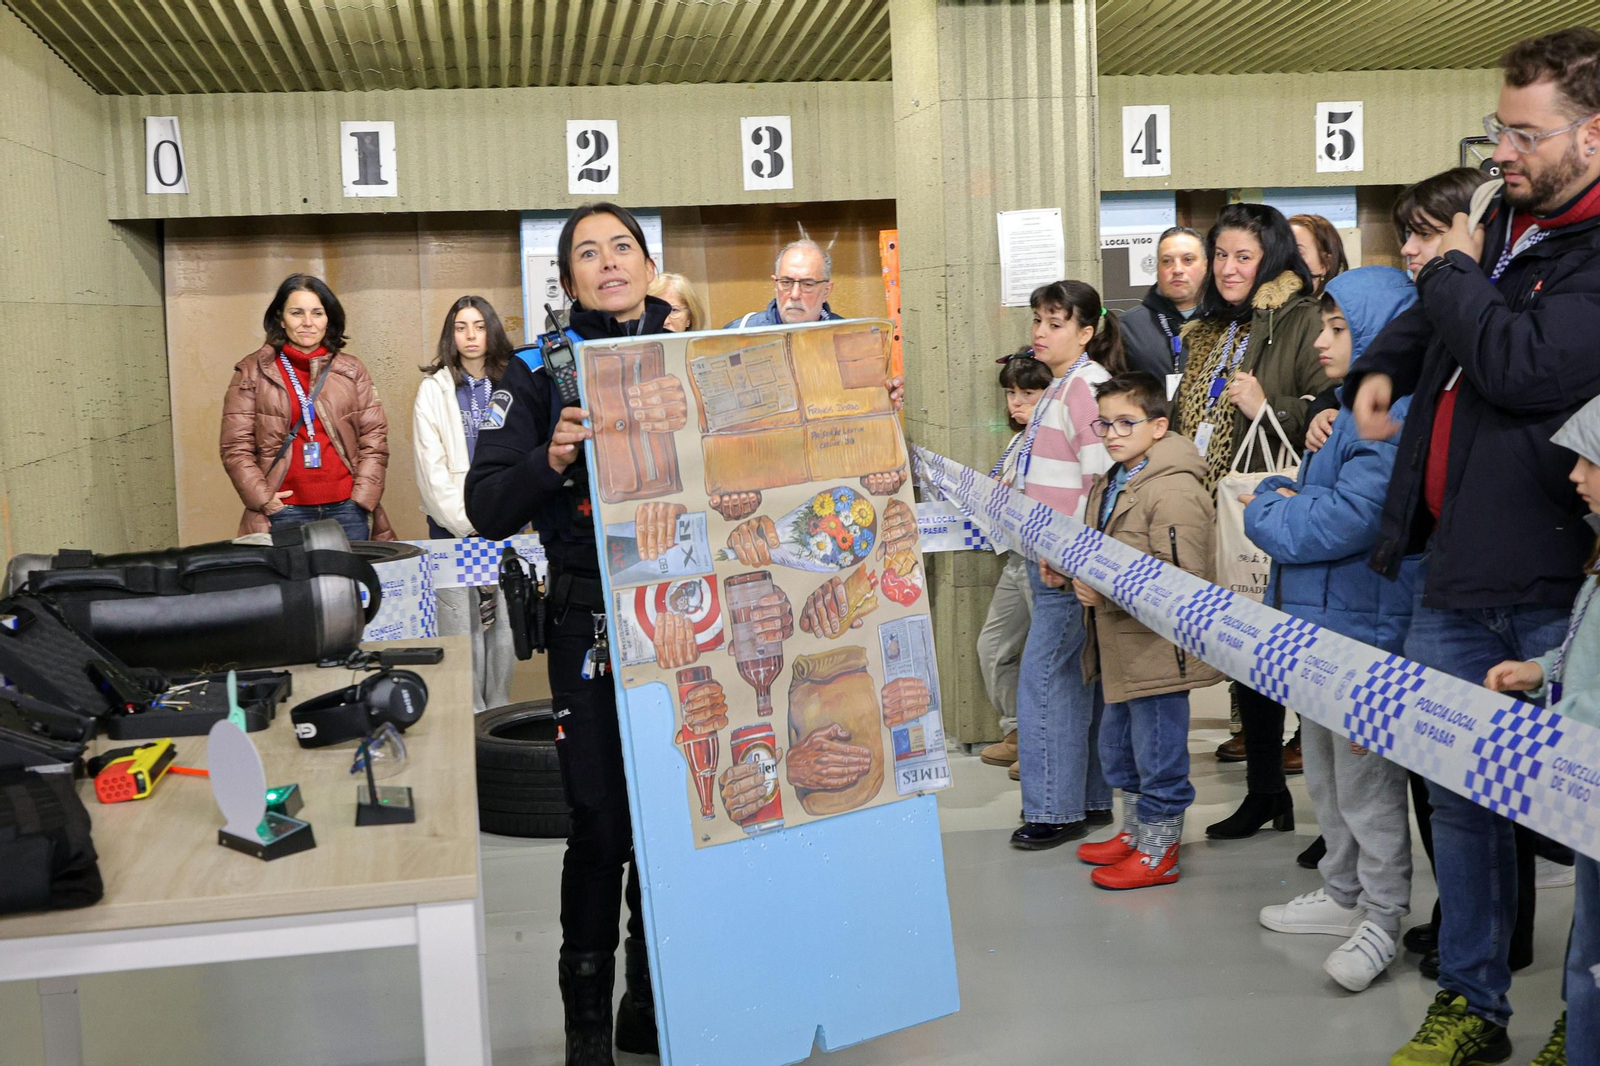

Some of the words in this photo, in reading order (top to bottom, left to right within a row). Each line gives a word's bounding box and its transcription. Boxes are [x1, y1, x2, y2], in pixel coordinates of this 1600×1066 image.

[1130, 113, 1162, 165] 4
[1324, 111, 1356, 161] 5
[153, 139, 183, 187] 0
[349, 131, 389, 186] 1
[576, 129, 611, 183] 2
[751, 125, 784, 179] 3
[1132, 237, 1153, 245] VIGO
[923, 527, 948, 535] PASAR
[610, 541, 626, 569] JVC
[370, 622, 404, 637] CONCELLO
[1220, 614, 1243, 632] POLICIA
[1240, 624, 1262, 638] LOCAL
[1217, 631, 1227, 642] NO
[1226, 634, 1244, 651] PASAR
[1300, 667, 1310, 680] DE
[1311, 670, 1327, 686] VIGO
[1304, 655, 1339, 675] CONCELLO
[1414, 697, 1450, 719] POLICIA
[1447, 710, 1477, 731] LOCAL
[1414, 720, 1428, 735] NO
[1427, 725, 1456, 748] PASAR
[903, 766, 949, 785] TIMES
[1550, 775, 1565, 792] DE
[1567, 781, 1591, 802] VIGO
